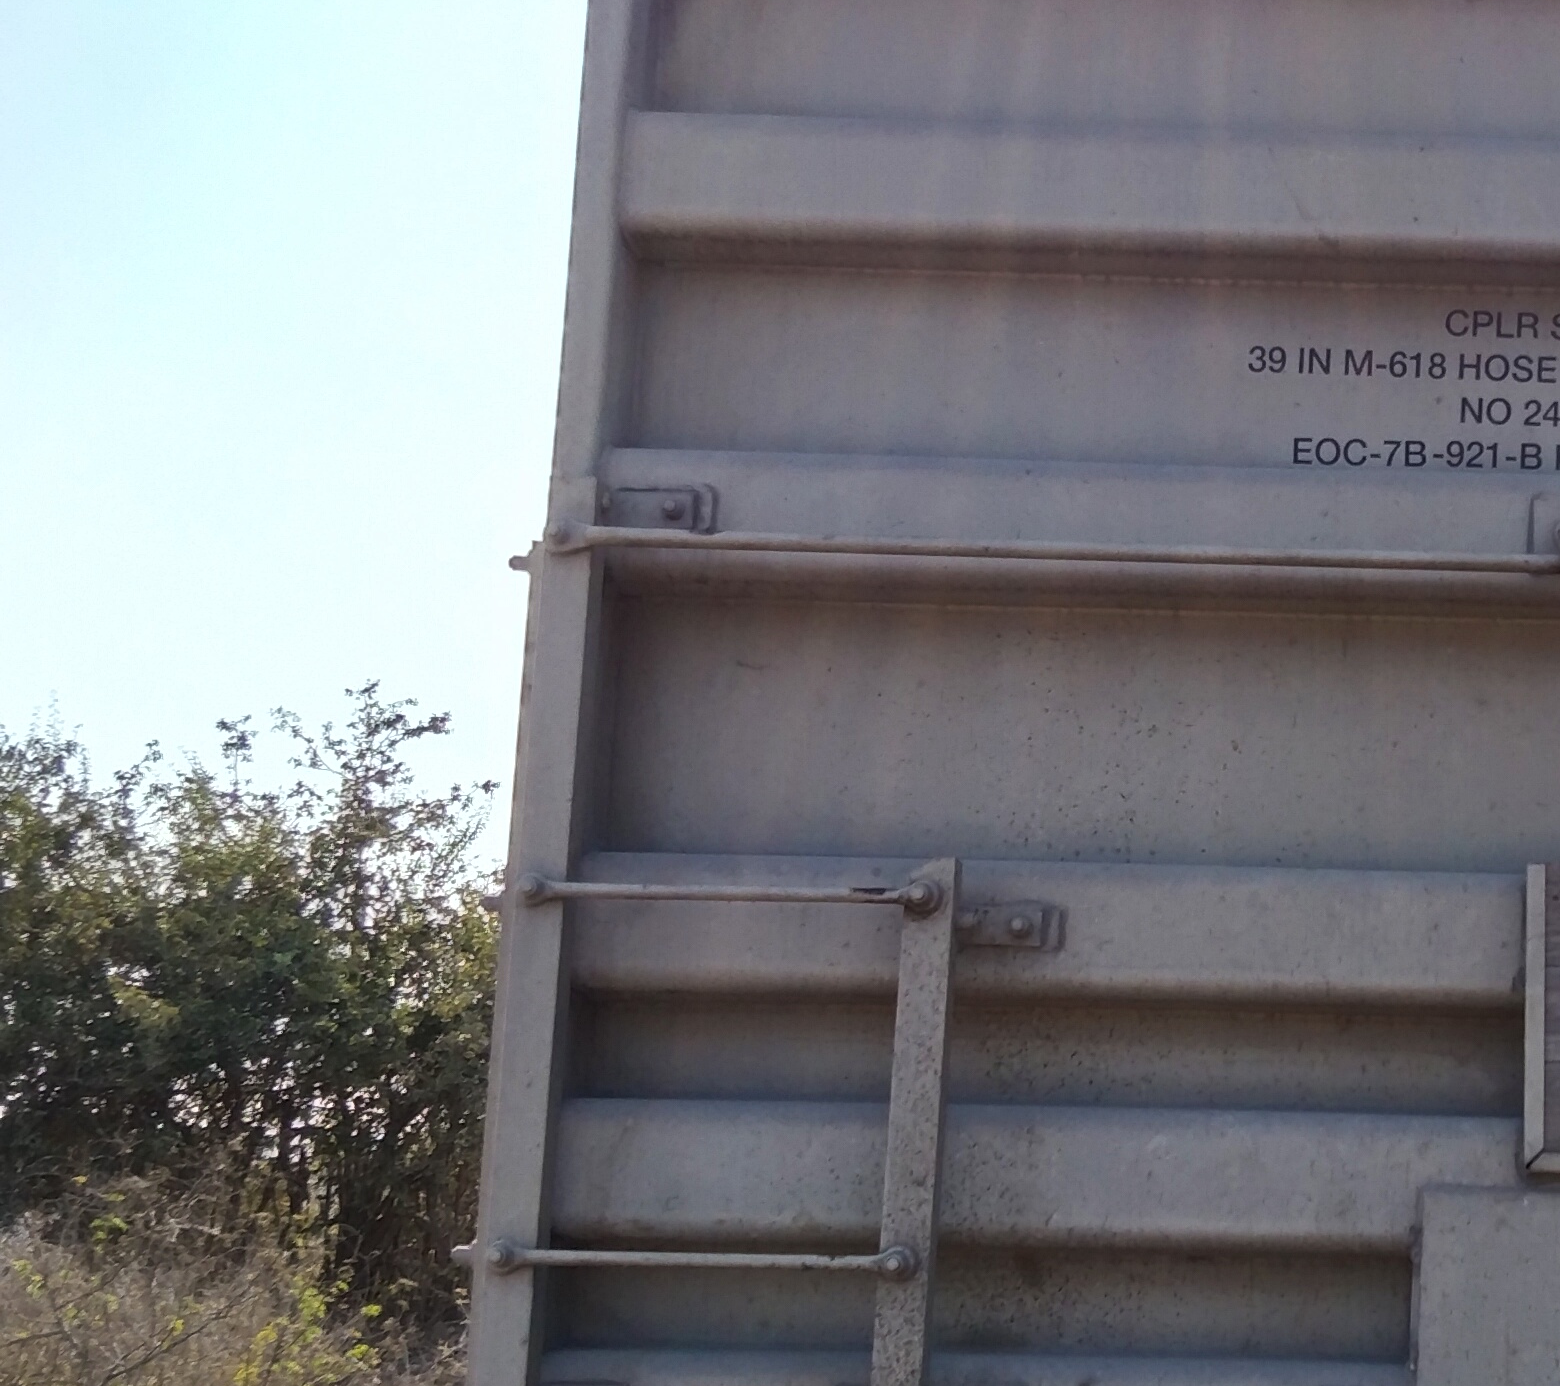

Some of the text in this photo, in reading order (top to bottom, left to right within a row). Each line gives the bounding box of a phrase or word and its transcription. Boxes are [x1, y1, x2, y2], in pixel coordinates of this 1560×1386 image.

[1445, 310, 1539, 339] CPLR
[1248, 346, 1287, 374] 39
[1298, 348, 1332, 375] IN
[1344, 350, 1447, 380] M-618
[1458, 354, 1557, 384] HOSE
[1460, 397, 1512, 426] NO
[1523, 400, 1560, 427] 24
[1292, 438, 1542, 470] EOC-7B-921-B
